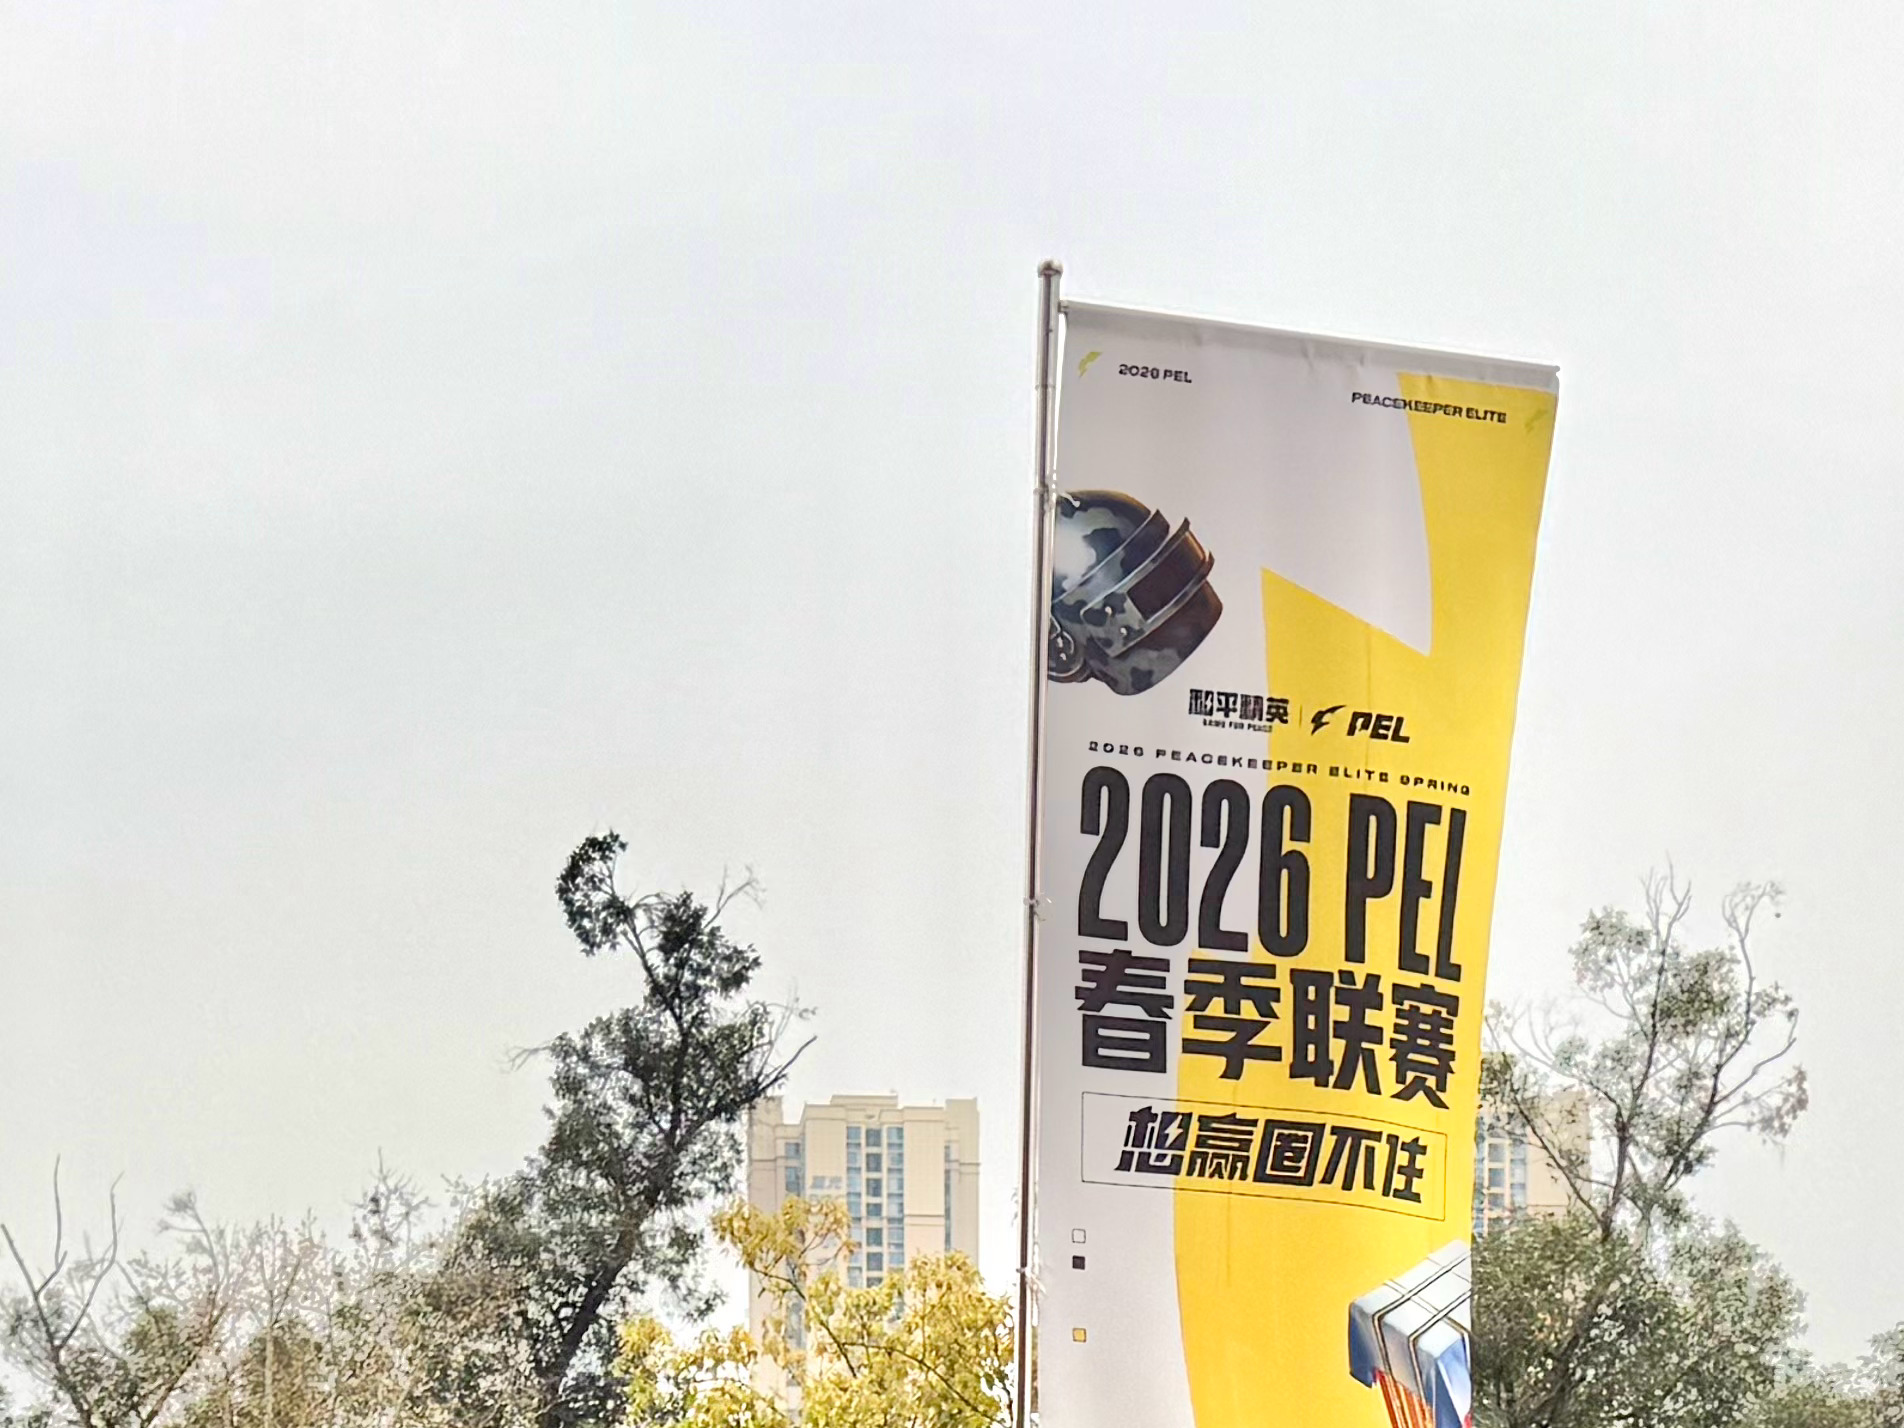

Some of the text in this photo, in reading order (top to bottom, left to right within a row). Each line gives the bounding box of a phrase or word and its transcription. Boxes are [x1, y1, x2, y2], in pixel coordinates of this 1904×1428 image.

[1162, 369, 1193, 384] PEL
[1346, 710, 1412, 744] PEL
[1155, 748, 1318, 776] PEACEKEEPER
[1328, 766, 1389, 784] ELITE
[1399, 774, 1471, 796] SPRING
[1077, 765, 1467, 983] 2026 PEL
[1074, 948, 1462, 1111] 春季联赛
[1114, 1104, 1428, 1205] 想赢圈不住
